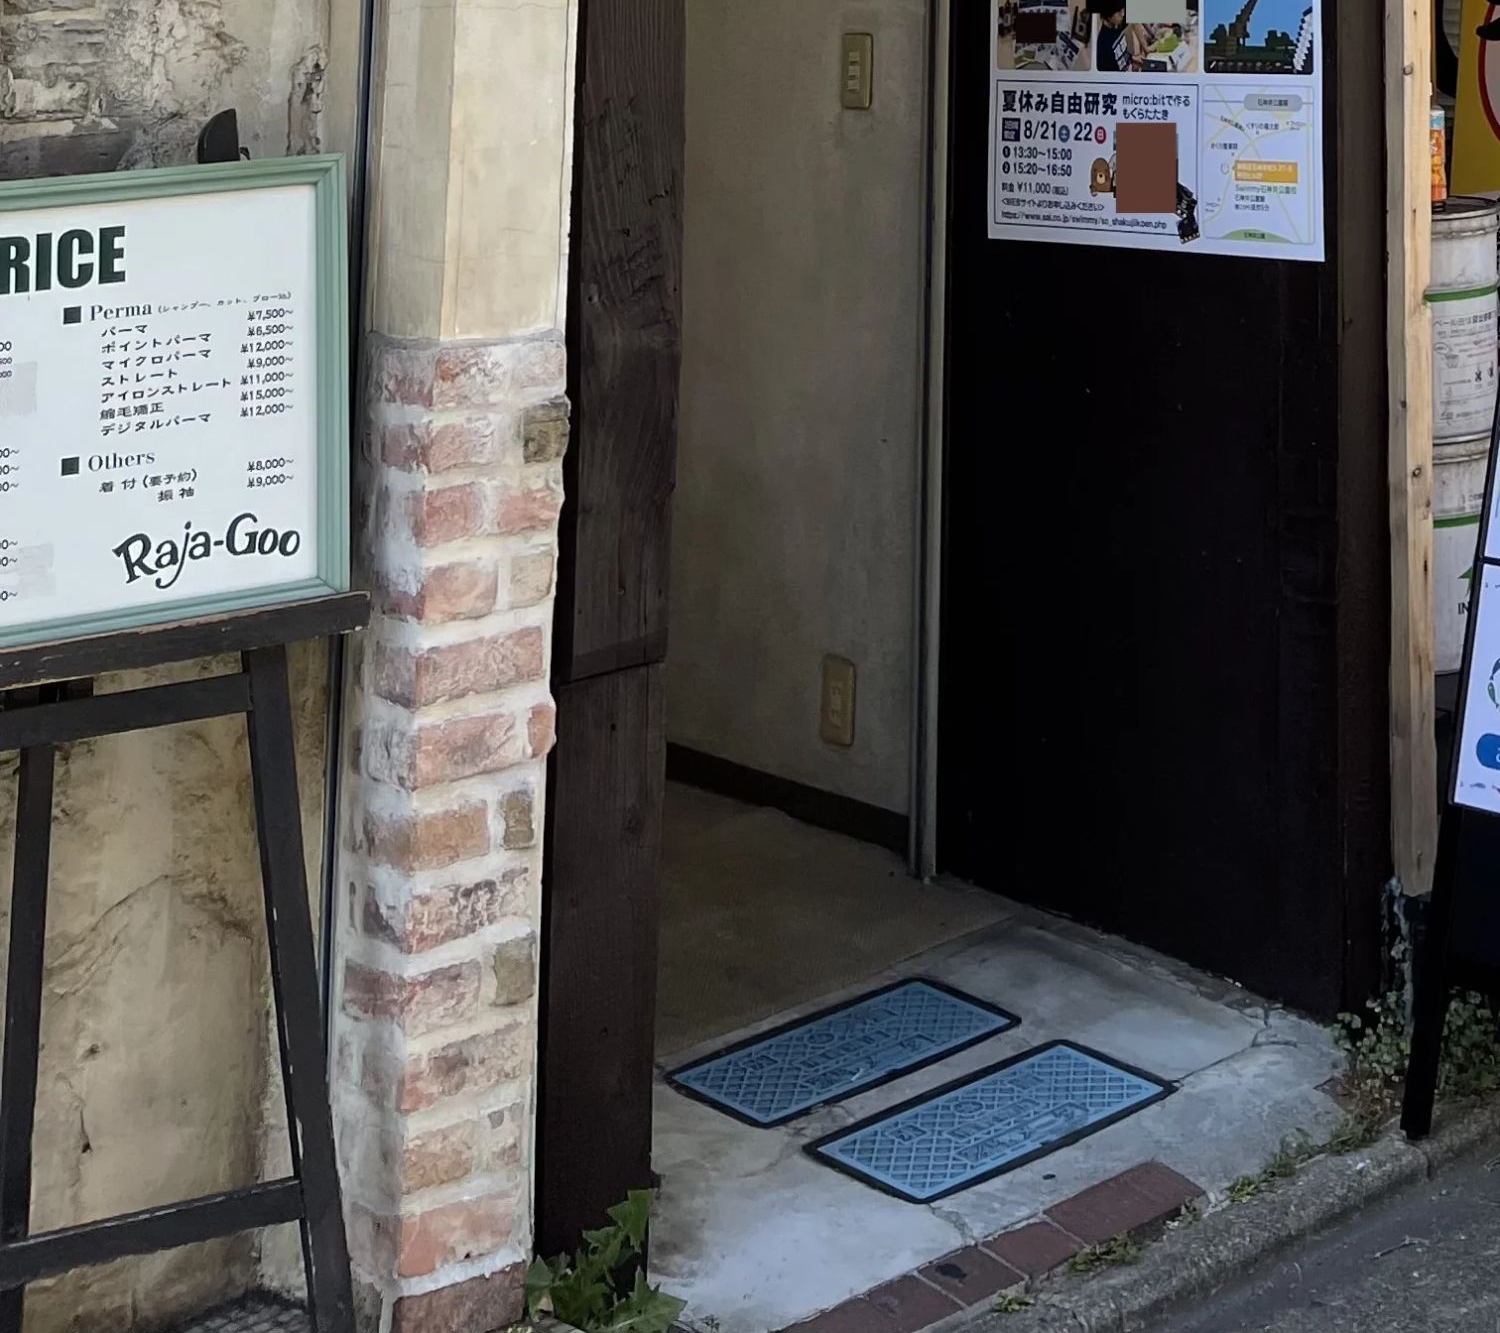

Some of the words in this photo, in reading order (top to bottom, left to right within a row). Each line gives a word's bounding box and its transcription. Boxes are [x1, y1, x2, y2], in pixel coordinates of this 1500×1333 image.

[1001, 89, 1118, 117] 夏休み自由研究
[1073, 121, 1093, 142] 22
[89, 301, 153, 322] Perma
[88, 451, 156, 473] Others
[112, 512, 301, 590] Raja-Goo
